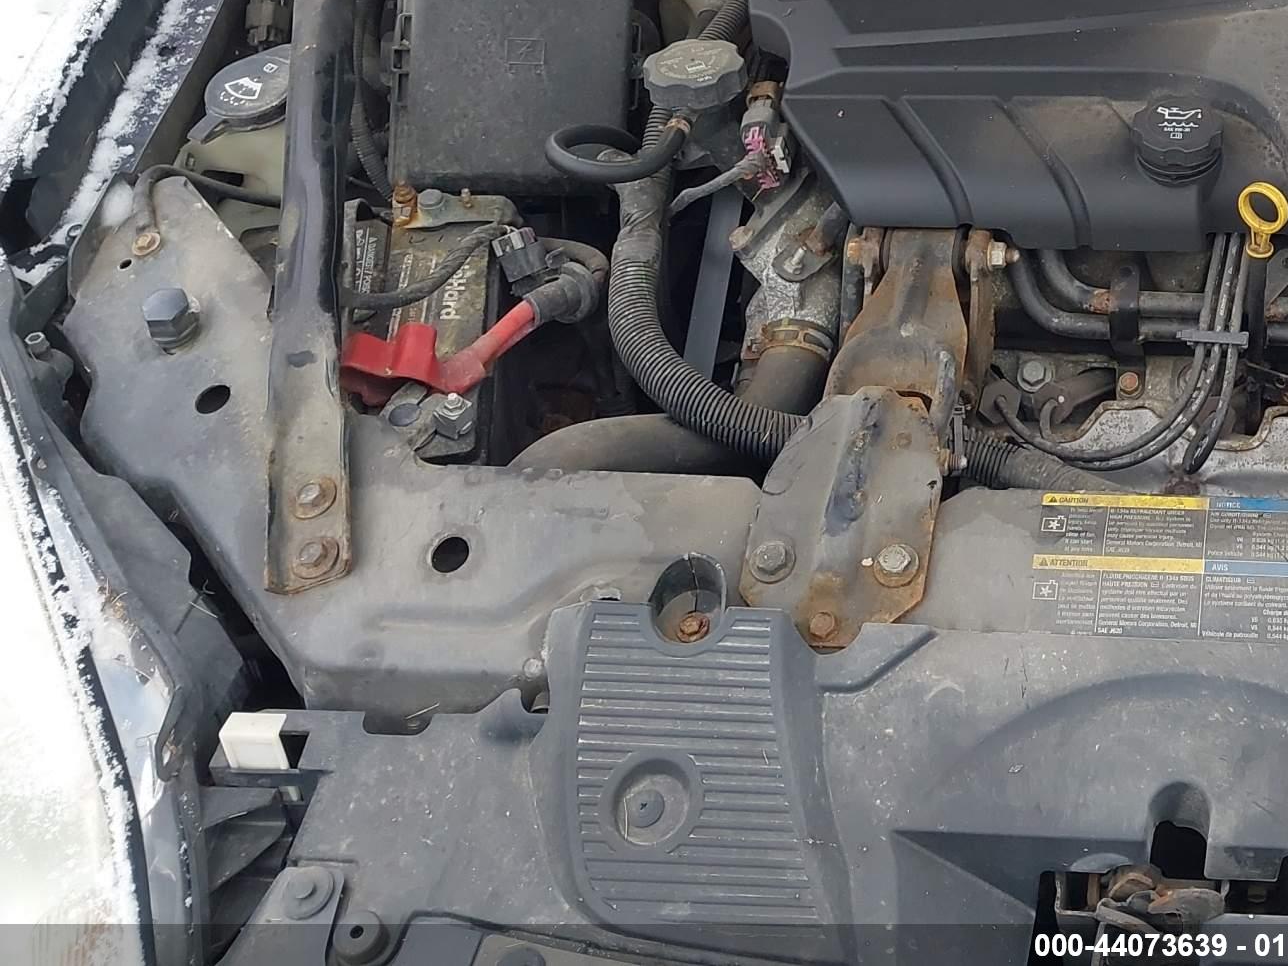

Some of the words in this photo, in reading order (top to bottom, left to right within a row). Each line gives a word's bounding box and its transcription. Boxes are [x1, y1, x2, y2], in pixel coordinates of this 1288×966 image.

[1216, 501, 1241, 509] NOTICE
[1049, 559, 1088, 567] ATTENTION
[1211, 563, 1229, 571] AVIS
